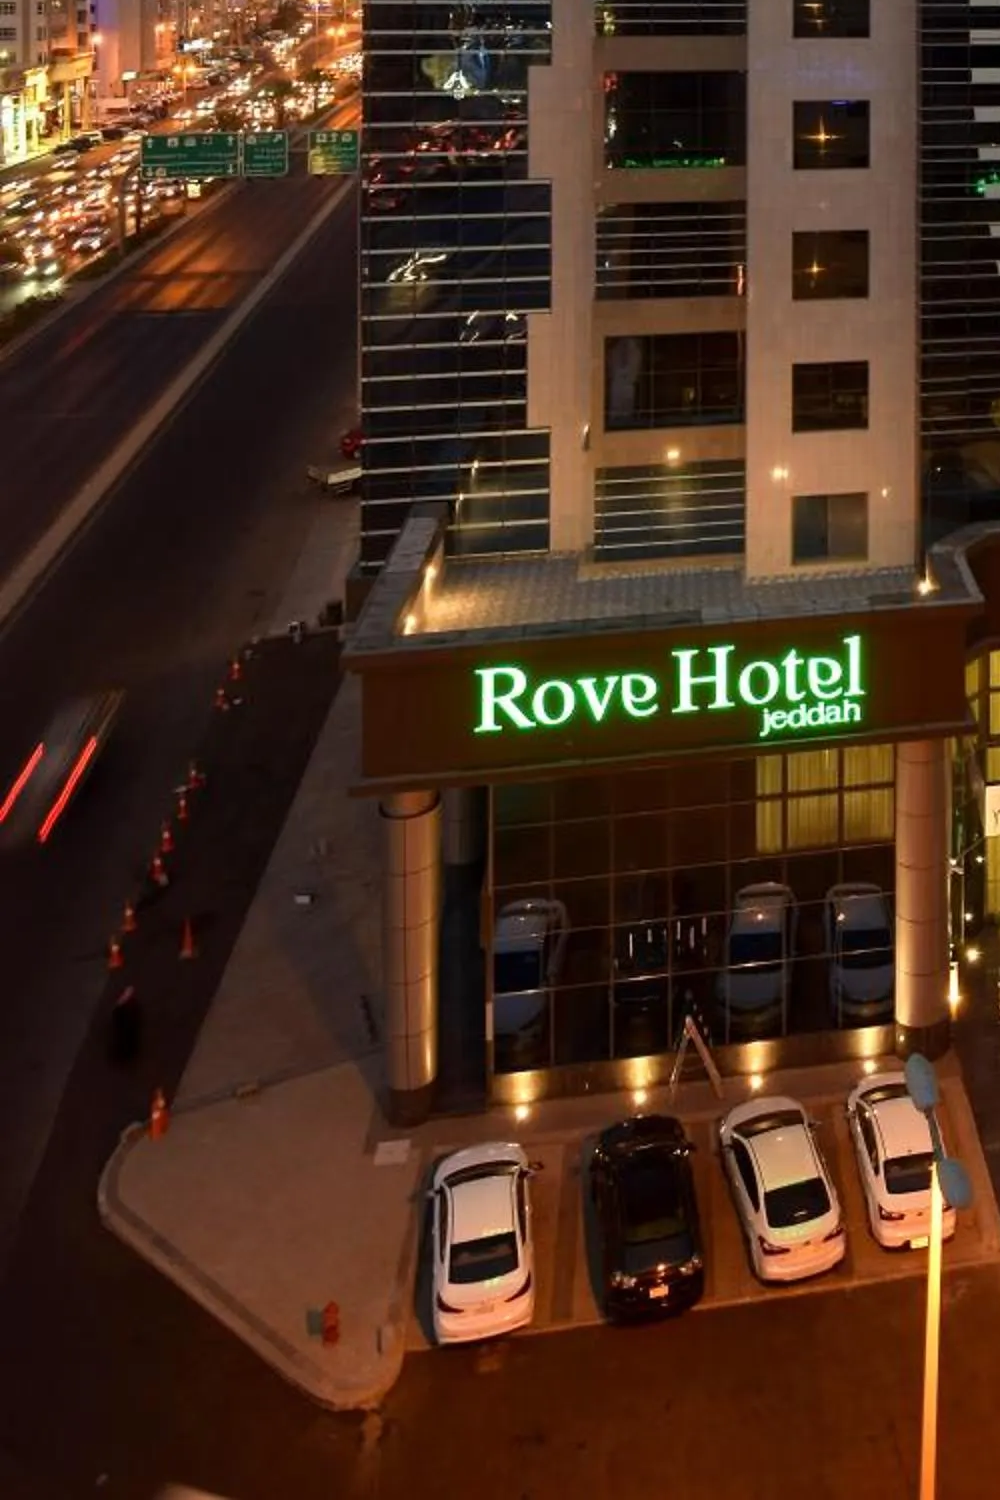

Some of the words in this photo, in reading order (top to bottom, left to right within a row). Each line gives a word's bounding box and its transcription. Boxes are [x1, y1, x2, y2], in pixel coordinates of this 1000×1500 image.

[473, 666, 660, 734] Rove
[671, 635, 867, 714] Hotel
[759, 699, 862, 737] jeddah
